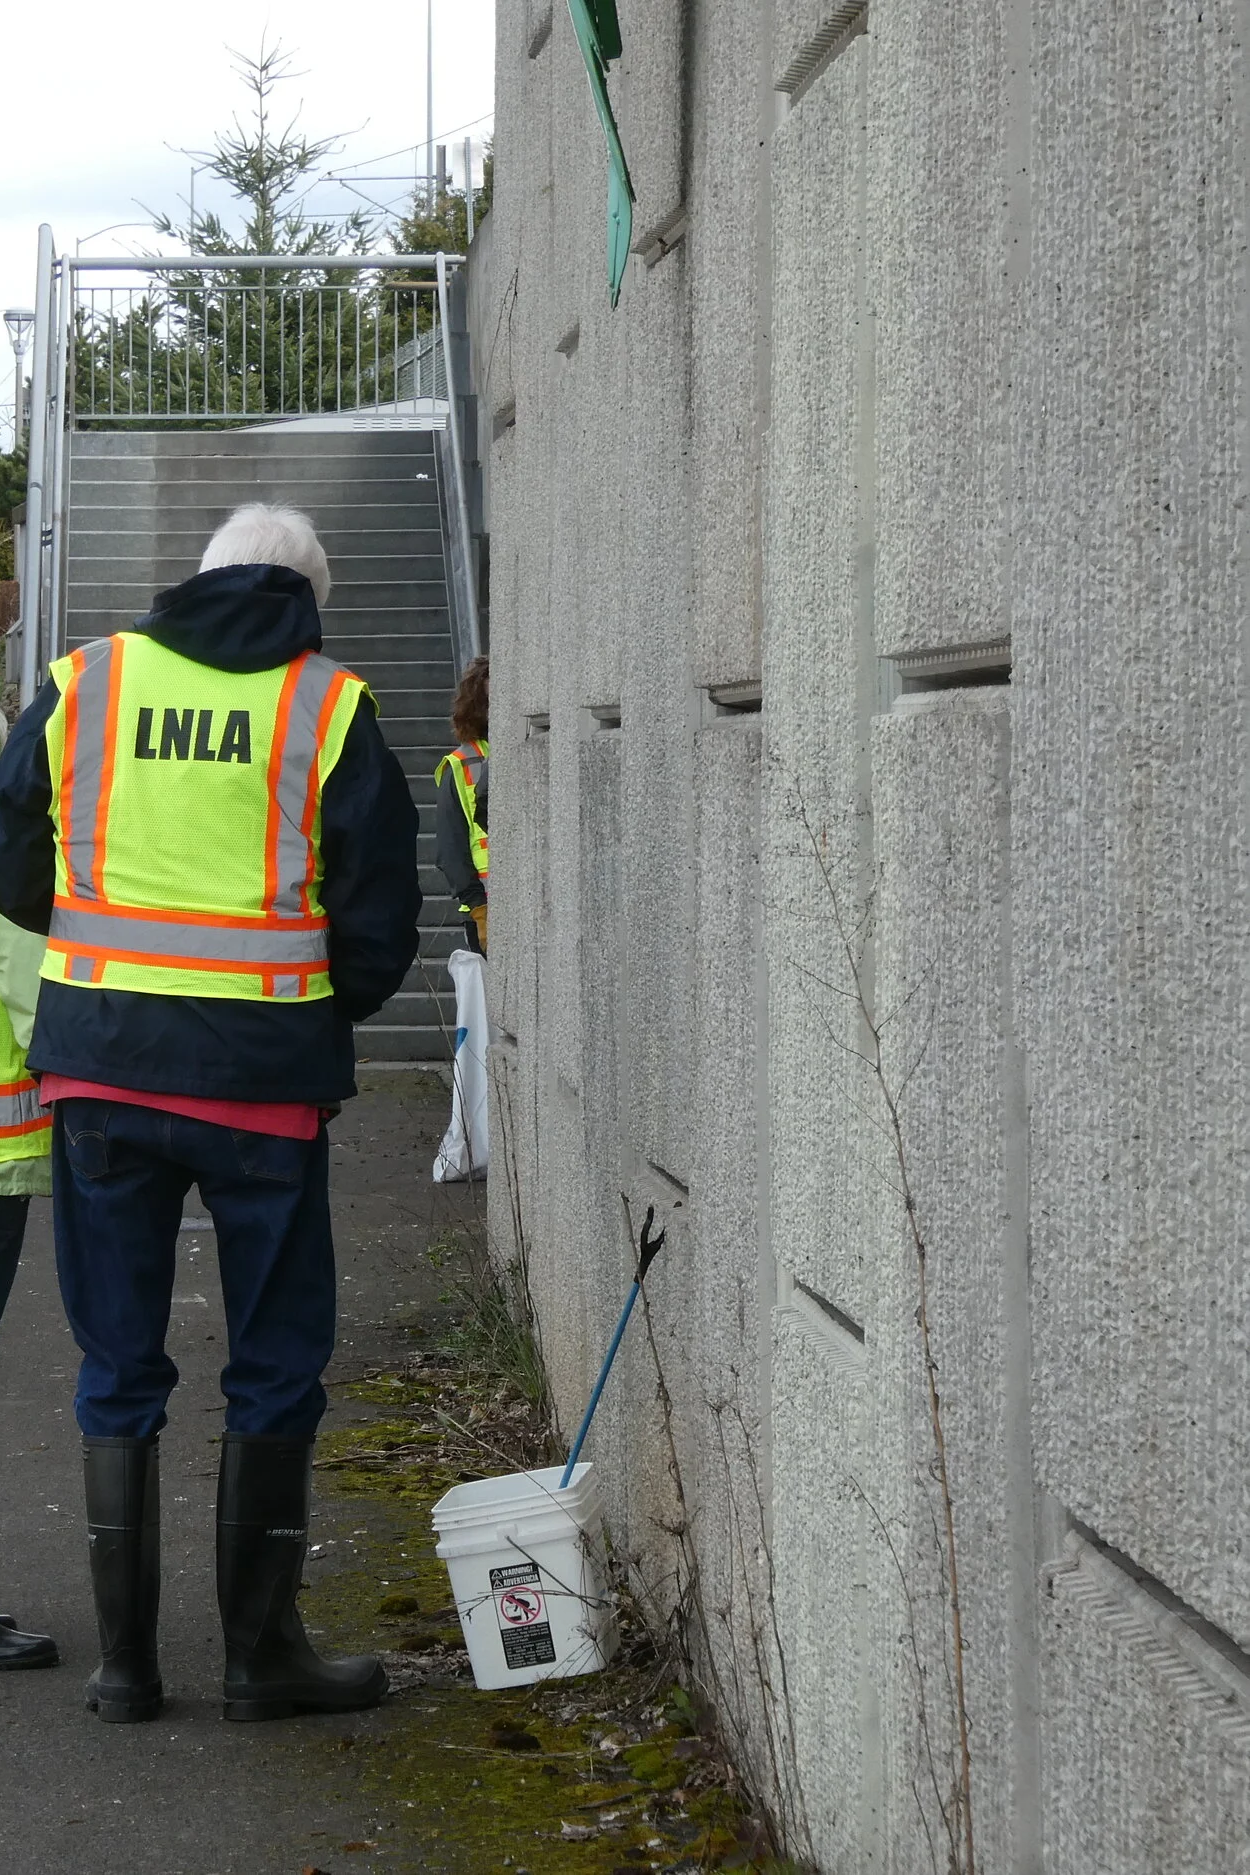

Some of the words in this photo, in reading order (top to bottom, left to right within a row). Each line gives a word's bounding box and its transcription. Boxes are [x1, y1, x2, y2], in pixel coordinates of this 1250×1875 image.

[134, 706, 252, 764] LNLA
[501, 1564, 533, 1578] WARNING!
[503, 1573, 539, 1588] ADVERTENCIA
